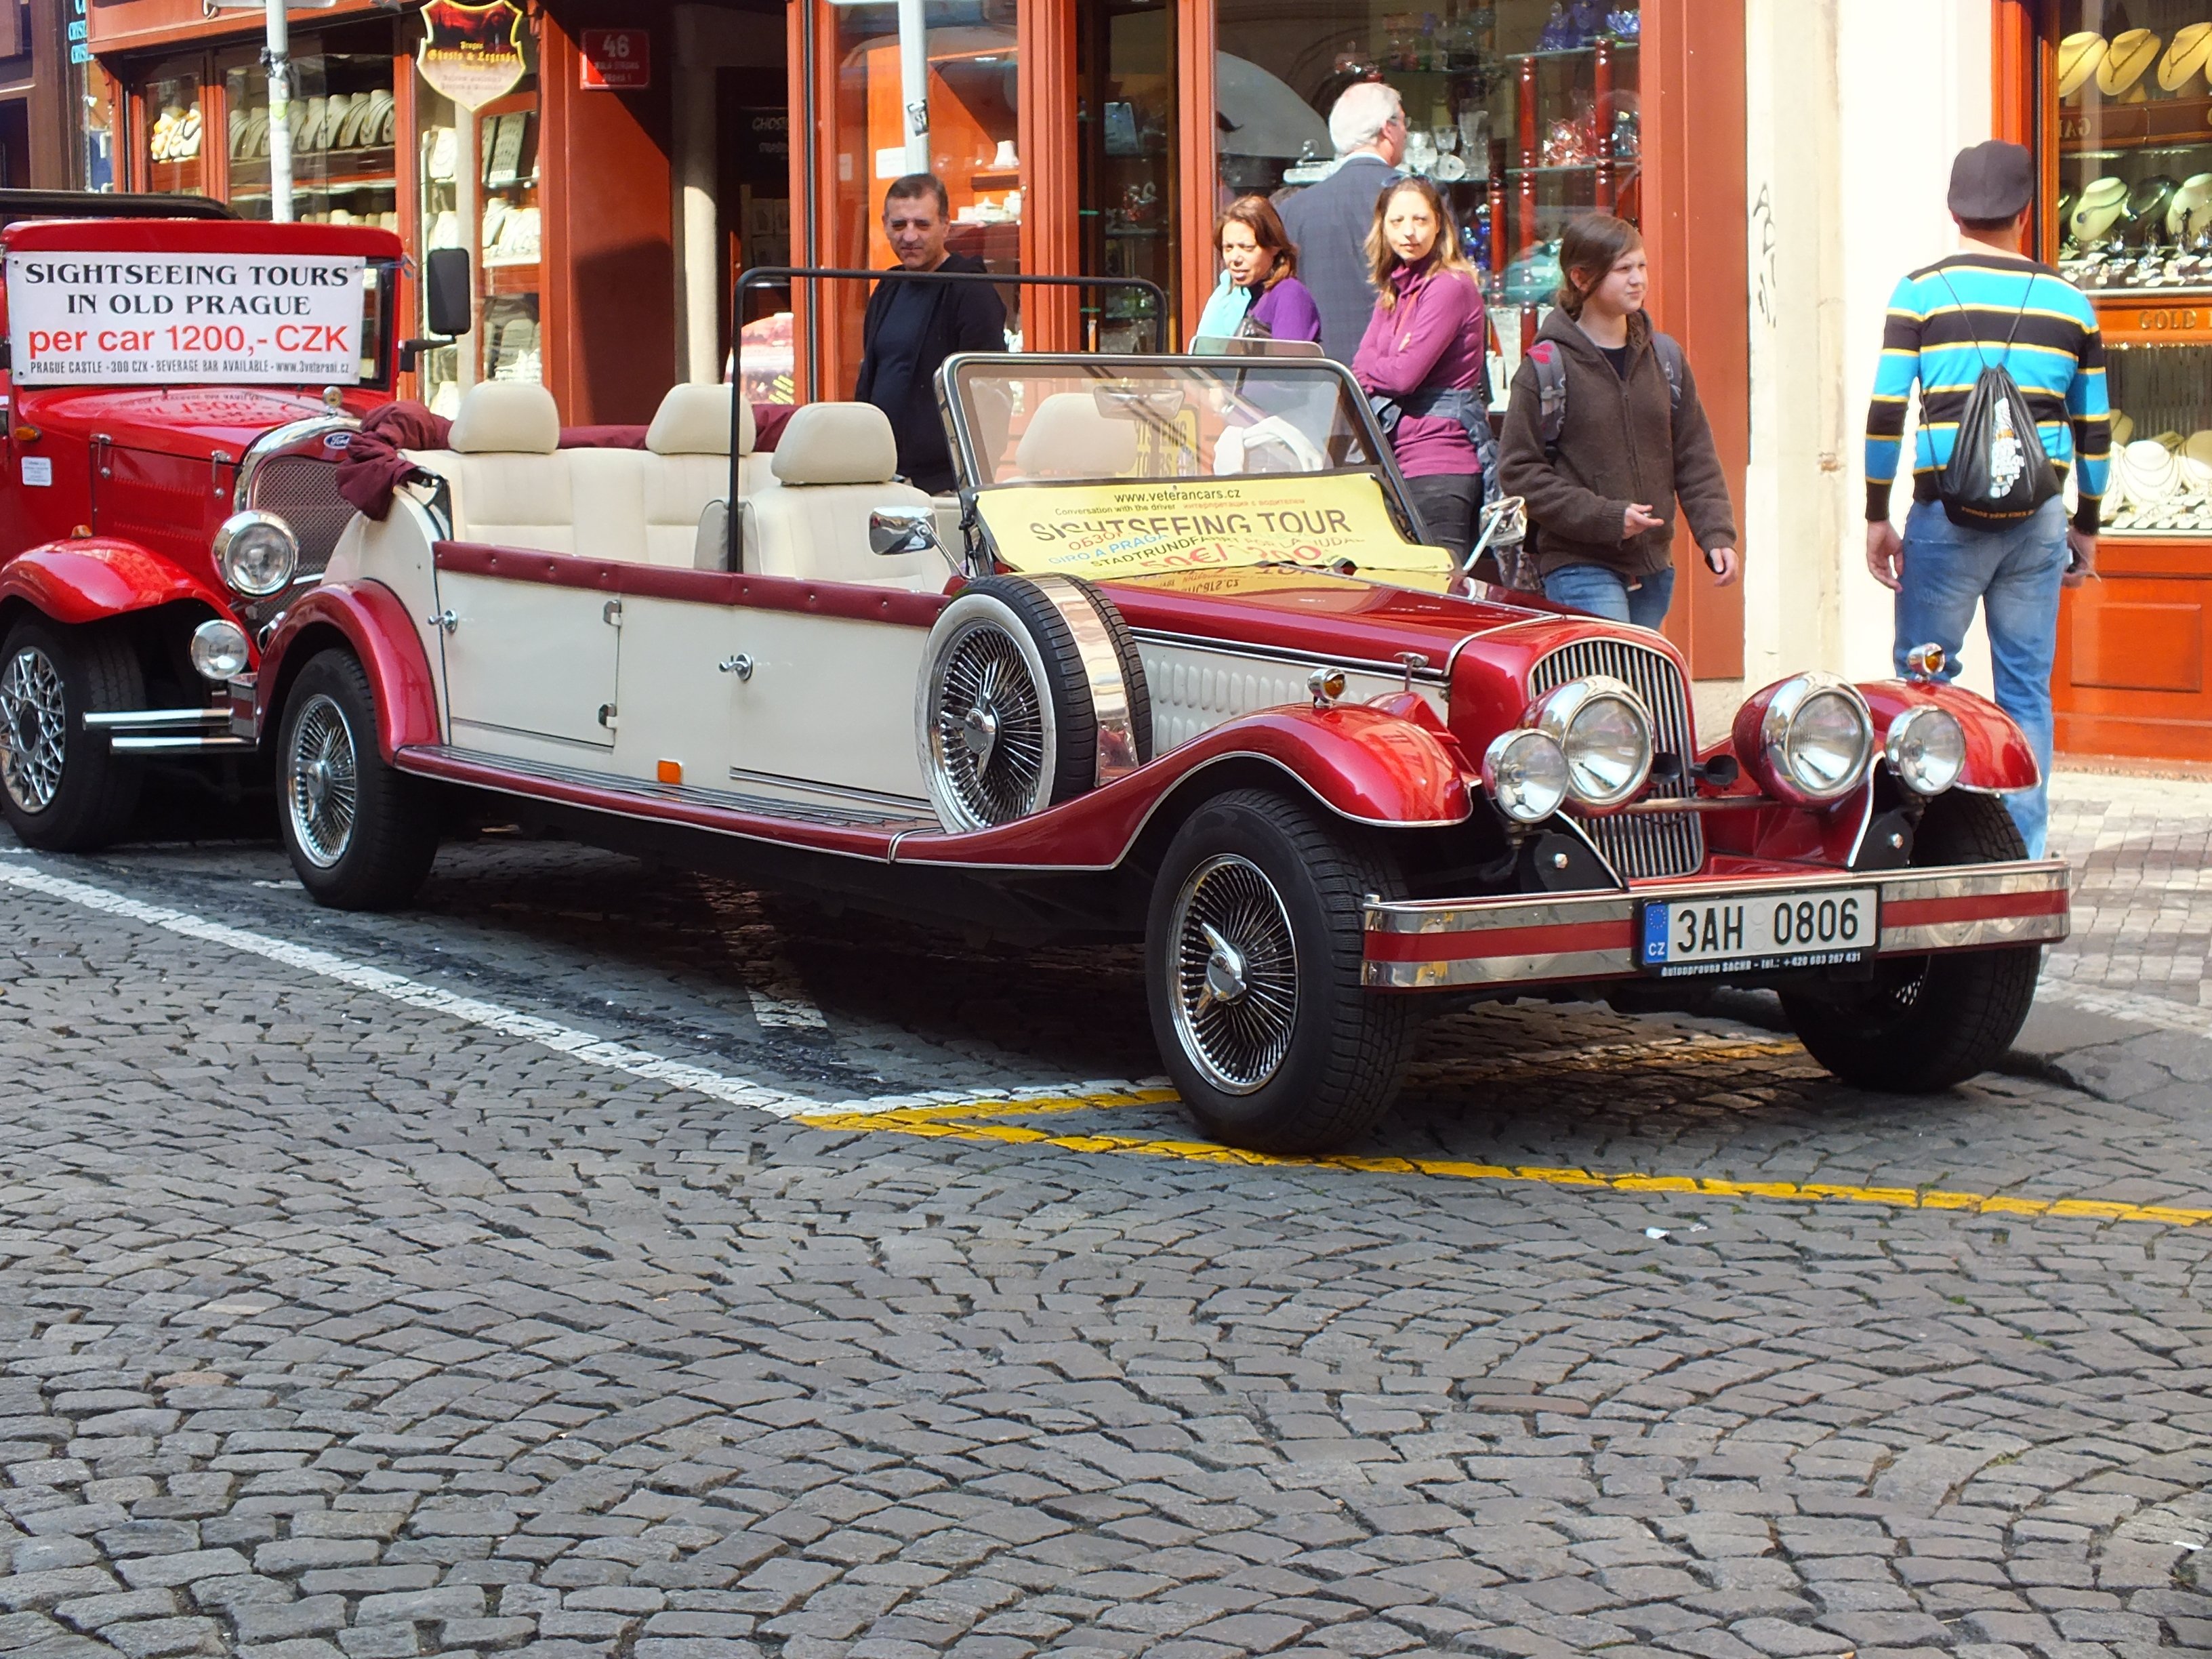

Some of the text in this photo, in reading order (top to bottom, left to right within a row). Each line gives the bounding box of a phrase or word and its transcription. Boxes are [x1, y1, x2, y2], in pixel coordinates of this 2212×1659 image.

[602, 34, 630, 58] 46
[477, 51, 517, 64] Legends
[26, 263, 349, 287] SIGHTSEEING TOURS
[68, 293, 311, 315] IN OLD PRAGUE
[2139, 310, 2196, 329] GOLD
[29, 325, 349, 359] per car 1200,- CZK
[30, 362, 66, 374] PRAGUE
[68, 361, 102, 374] CASTLE
[156, 361, 199, 373] BEVERAGE
[202, 361, 219, 373] BAR
[222, 361, 269, 373] AVAILABLE
[1114, 489, 1242, 503] www.veterancars.cz
[1055, 503, 1176, 516] Conversation with the driver
[1257, 510, 1351, 535] TOUR
[1094, 549, 1106, 559] A
[1677, 897, 1859, 953] 3AH 0806
[1648, 942, 1665, 956] CZ
